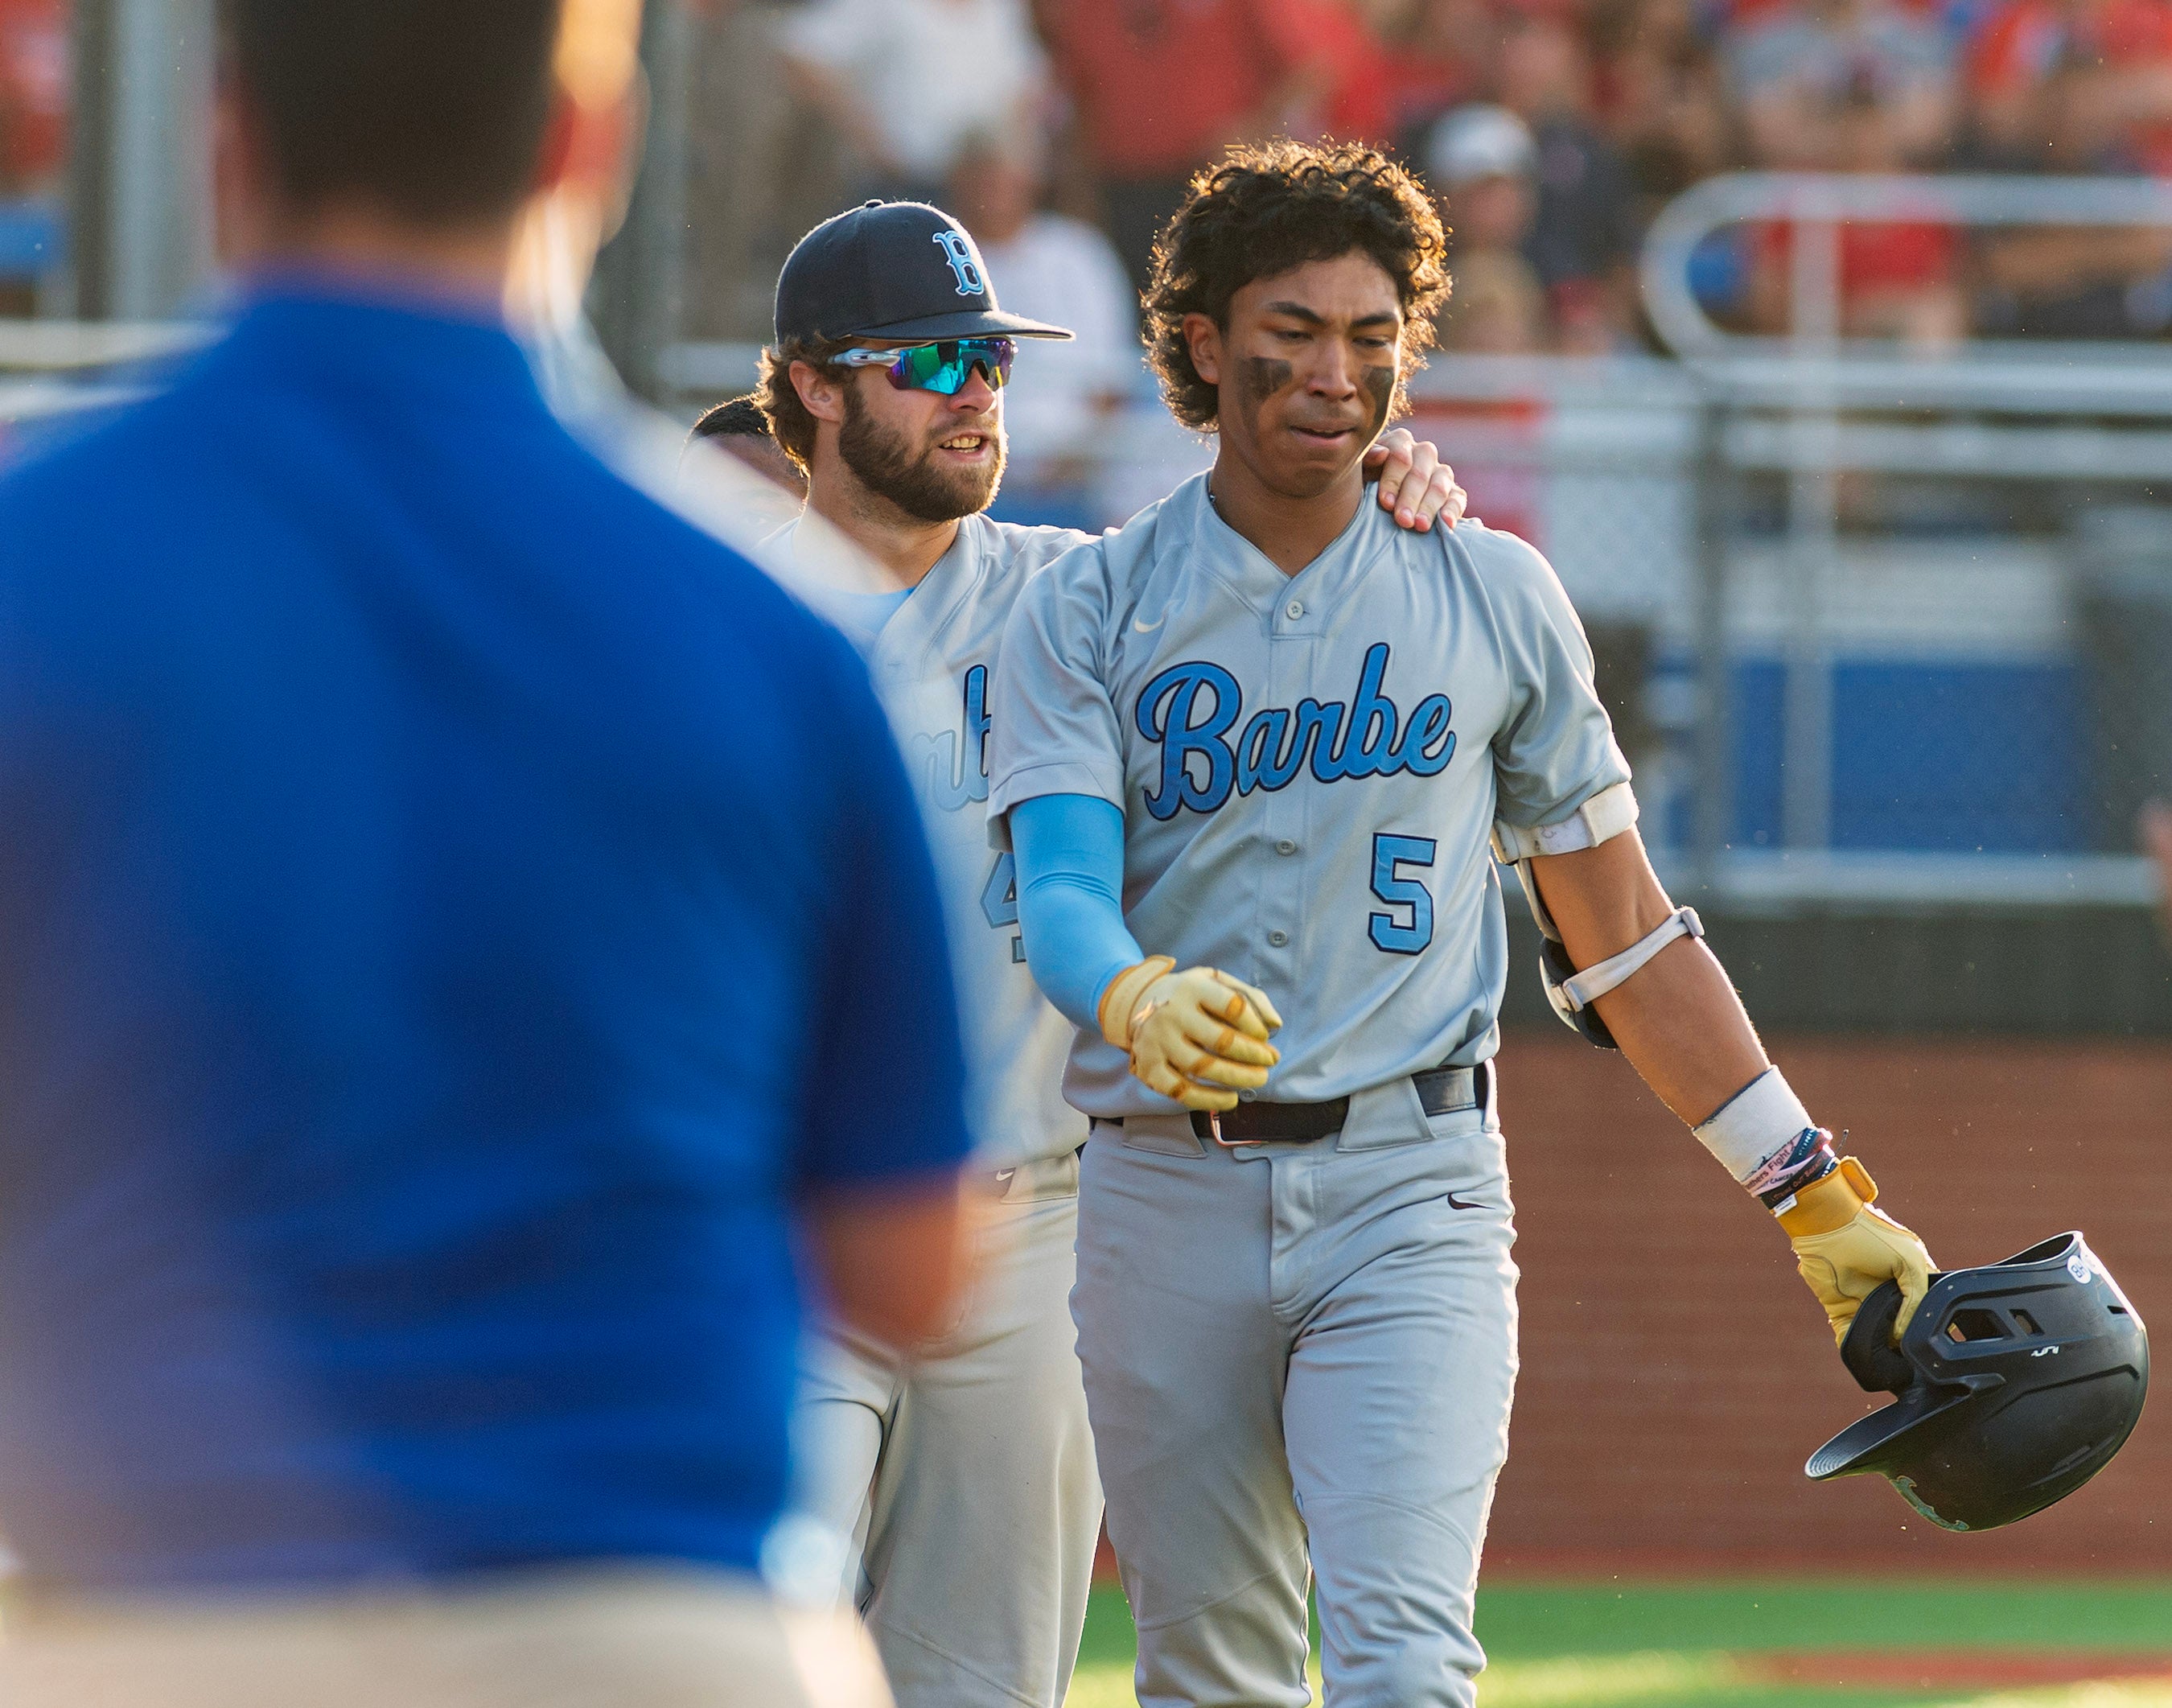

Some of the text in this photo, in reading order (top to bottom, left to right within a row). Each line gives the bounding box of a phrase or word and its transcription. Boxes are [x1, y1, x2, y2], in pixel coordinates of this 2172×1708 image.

[932, 230, 984, 296] B
[1135, 642, 1456, 821] Barbe
[1368, 833, 1438, 956] 5
[1767, 1150, 1791, 1171] Fight
